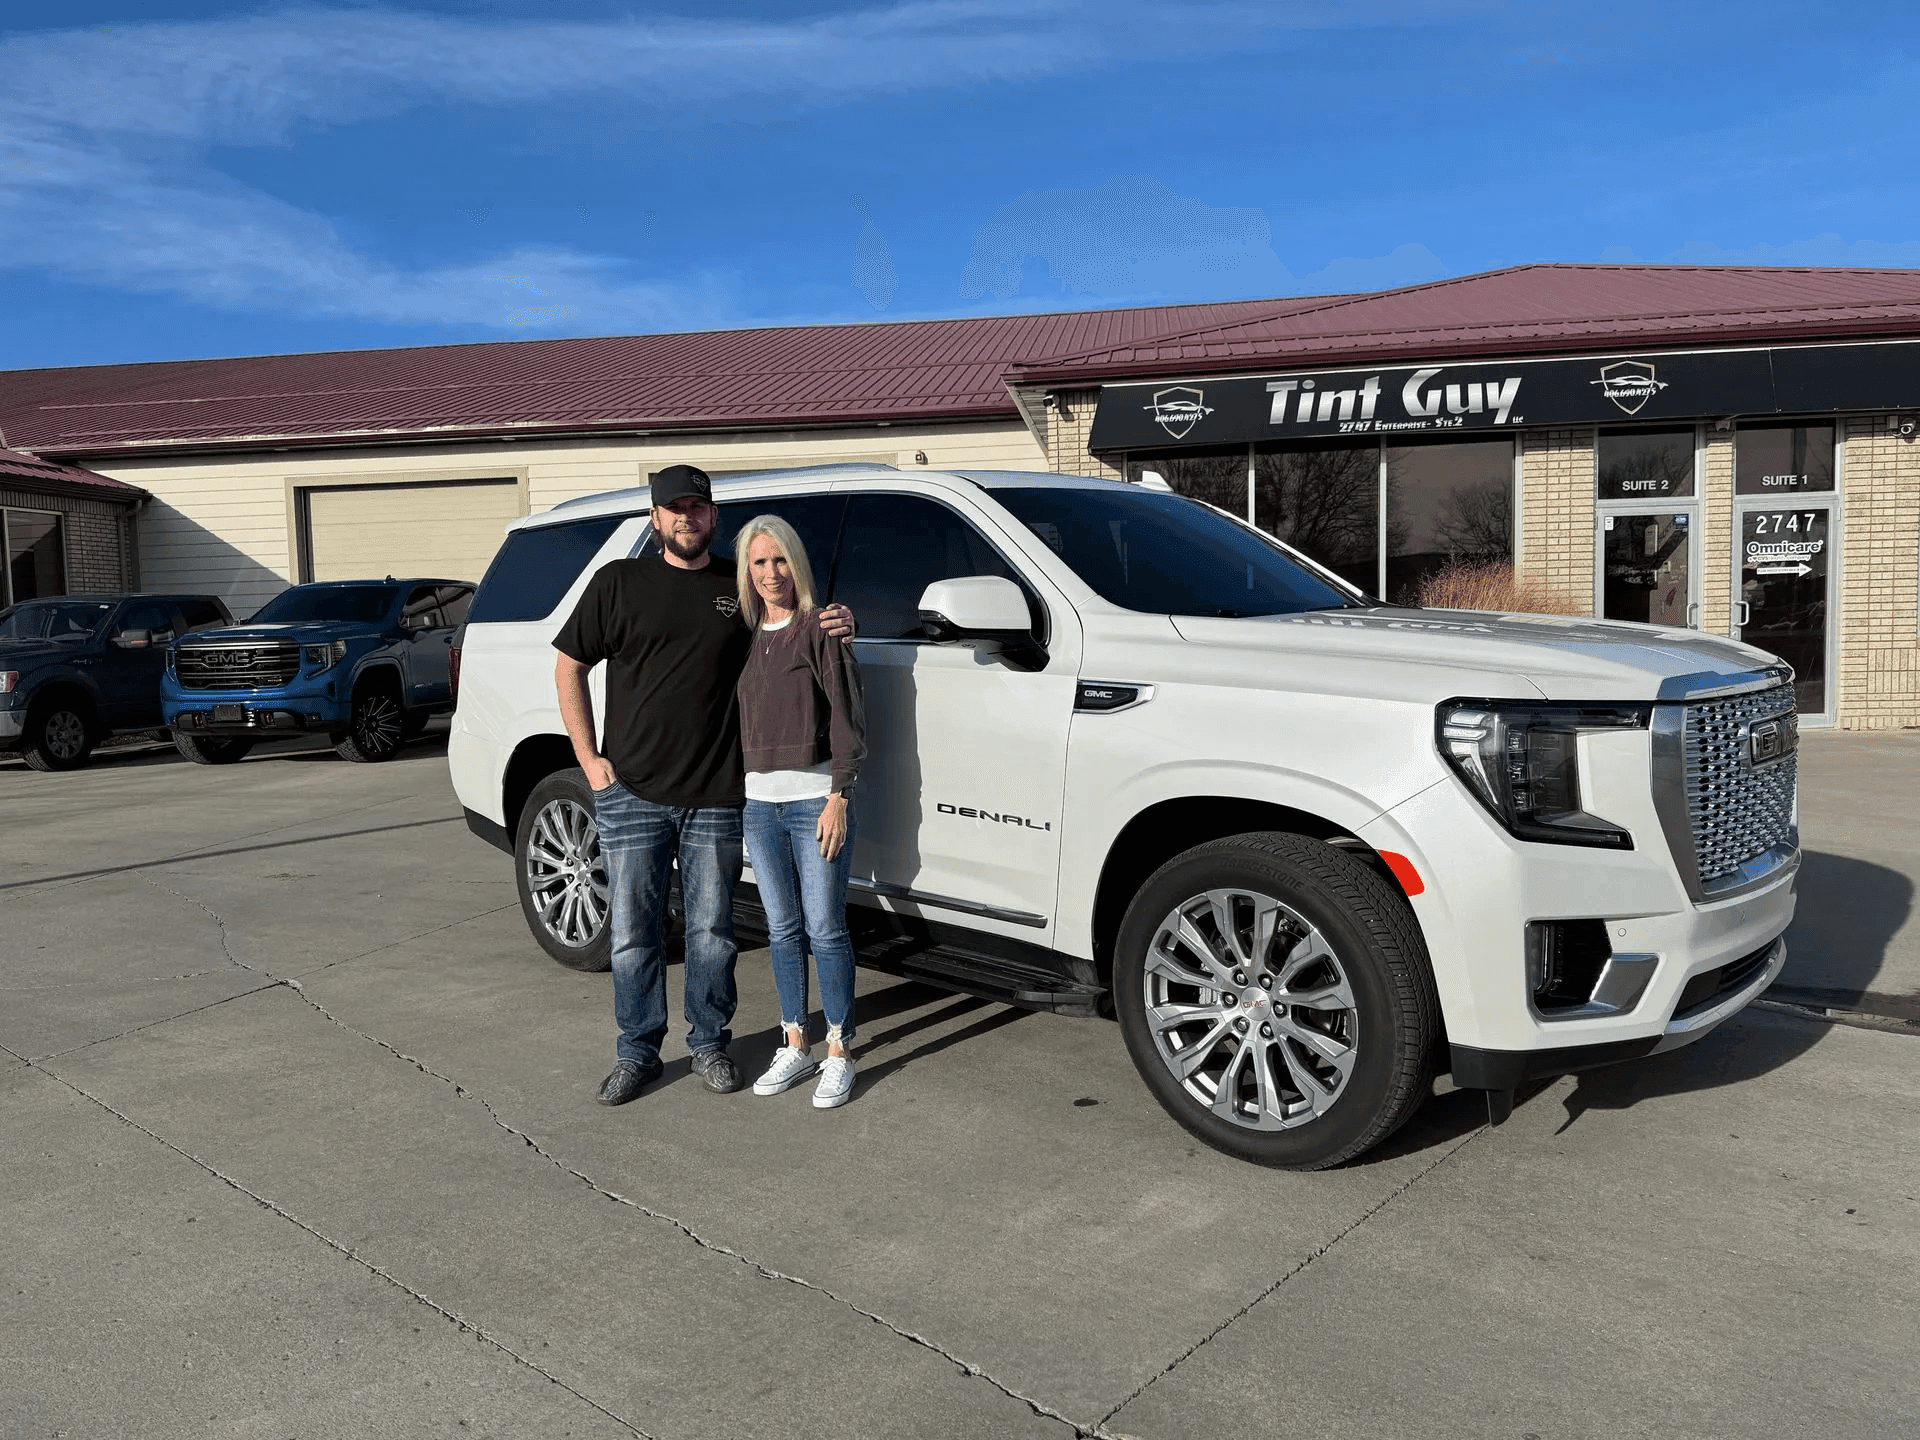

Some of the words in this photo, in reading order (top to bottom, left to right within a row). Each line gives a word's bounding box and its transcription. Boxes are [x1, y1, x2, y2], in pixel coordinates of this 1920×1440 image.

[1266, 376, 1381, 424] Tint
[1402, 368, 1522, 425] Guy
[1622, 480, 1656, 491] SUITE
[1661, 480, 1669, 490] 2
[1762, 475, 1797, 486] SUITE
[1801, 475, 1808, 485] 1
[1756, 513, 1815, 534] 2747
[1747, 541, 1821, 555] Omnicare
[205, 653, 250, 663] GMC
[1084, 690, 1113, 699] GMC
[937, 803, 1051, 831] DENALI
